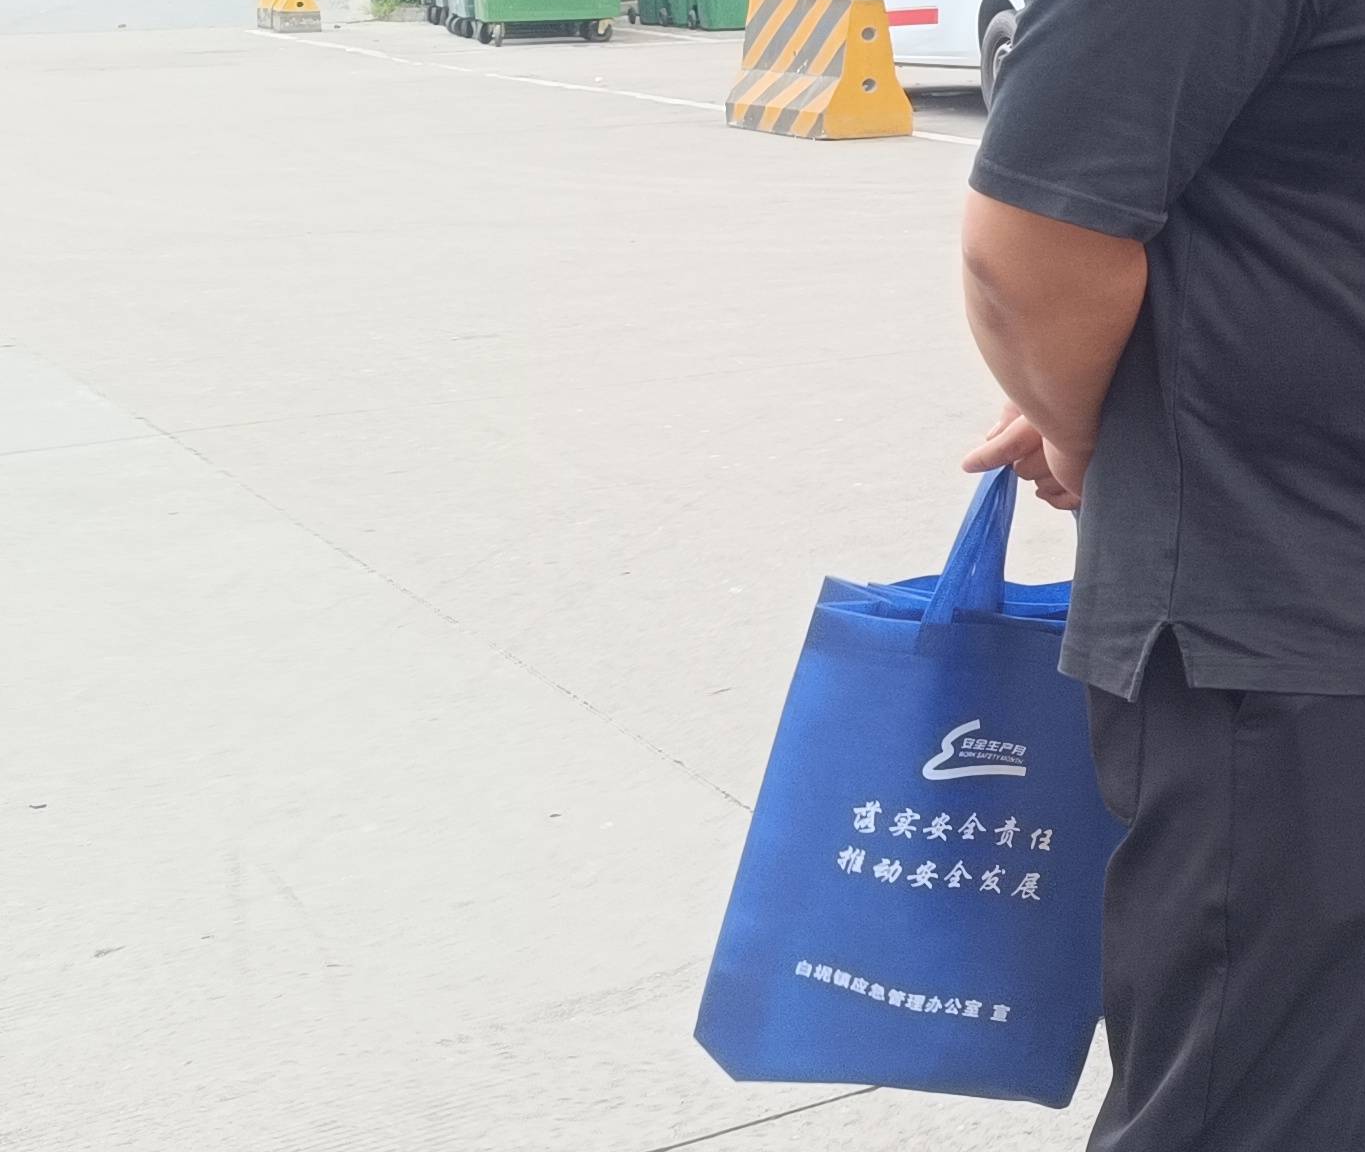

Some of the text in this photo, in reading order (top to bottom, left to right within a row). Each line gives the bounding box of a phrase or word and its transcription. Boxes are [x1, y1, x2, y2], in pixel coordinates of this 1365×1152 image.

[961, 737, 1026, 757] 安全生产月
[853, 800, 1053, 852] 落实安全责任
[837, 845, 1041, 901] 推动安全发展
[795, 959, 983, 1019] 白坭镇应急管理办公室
